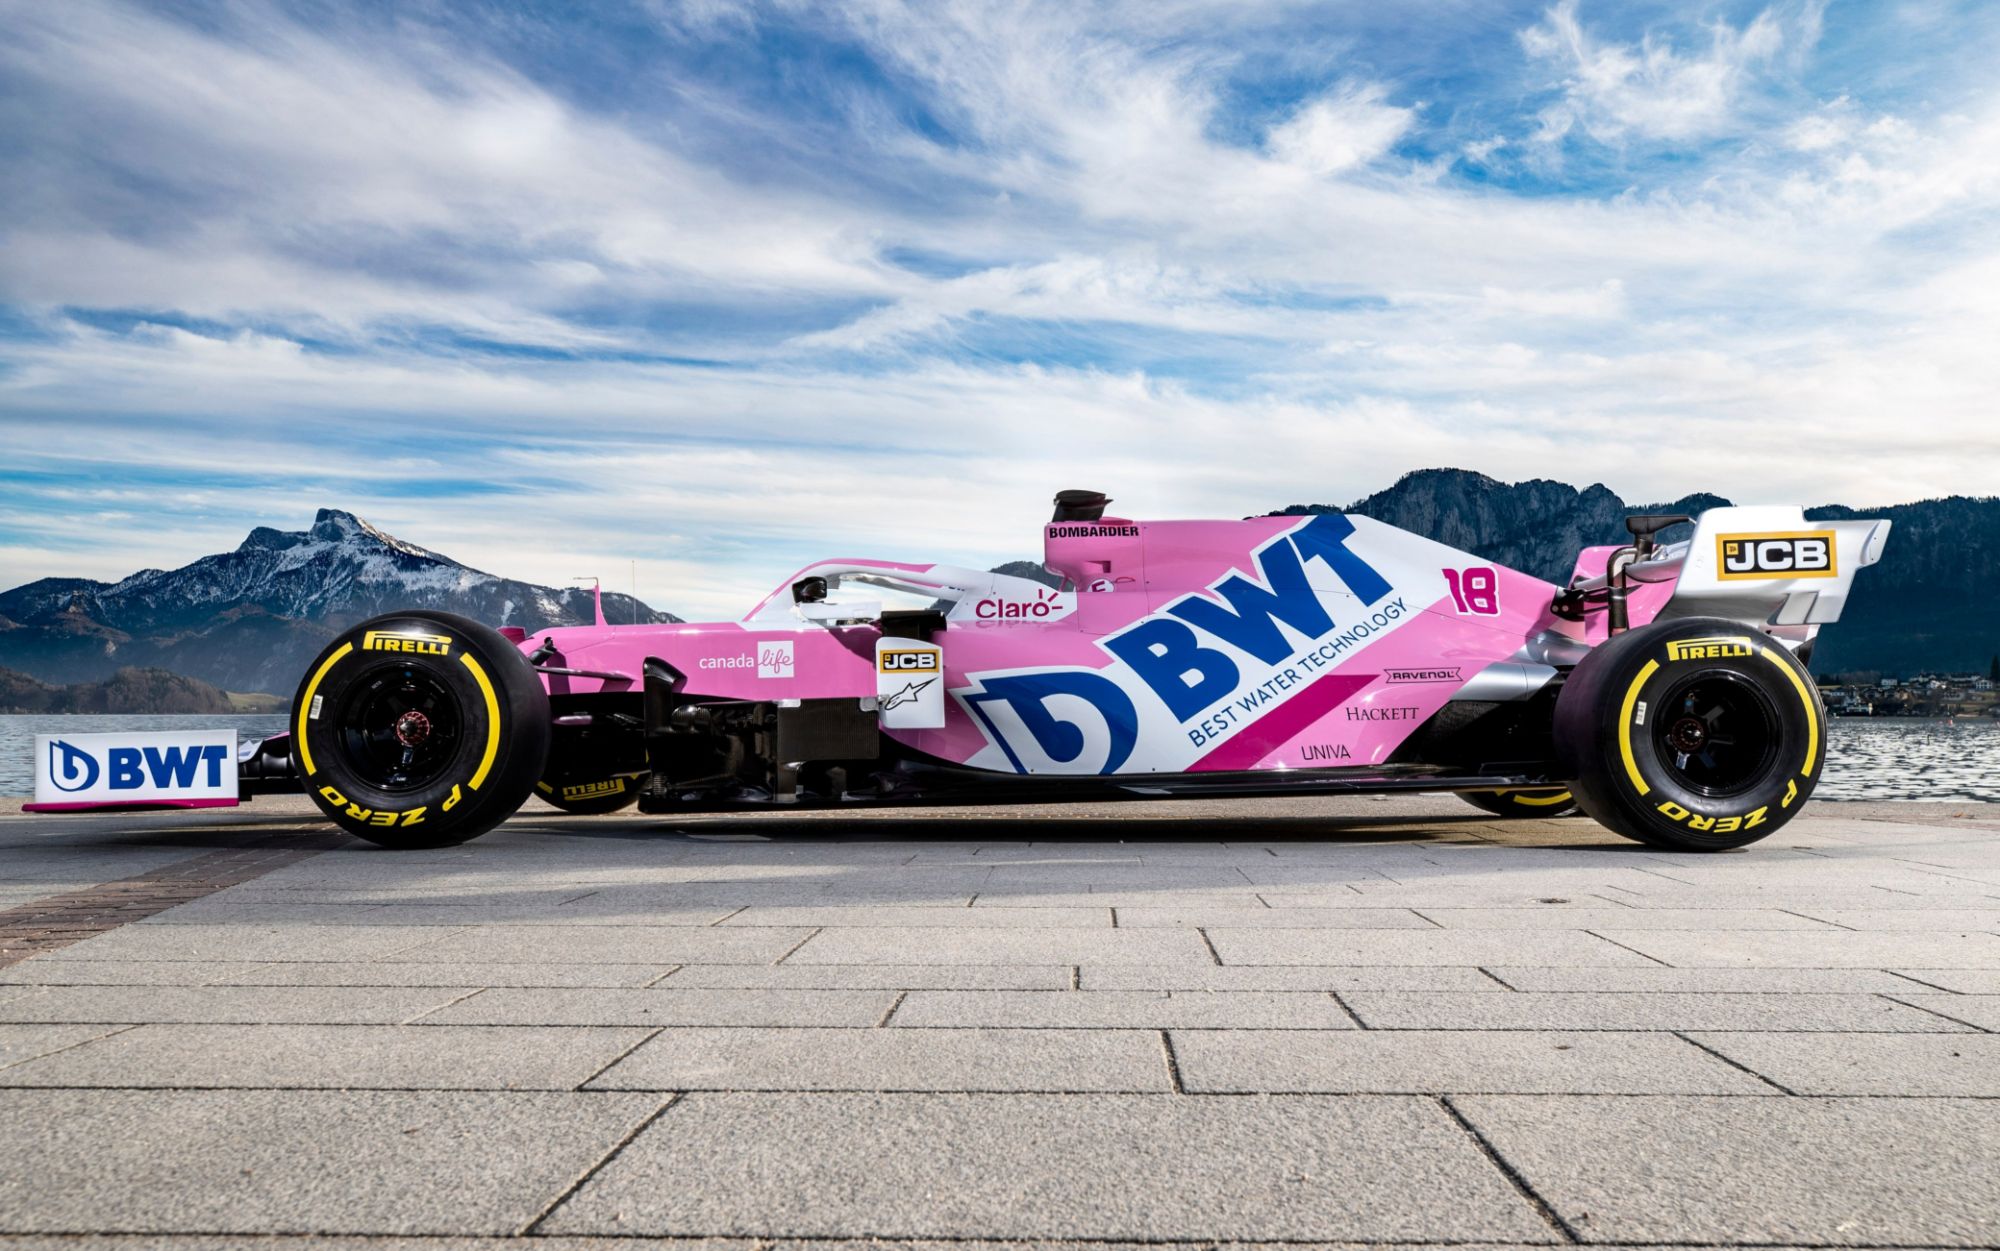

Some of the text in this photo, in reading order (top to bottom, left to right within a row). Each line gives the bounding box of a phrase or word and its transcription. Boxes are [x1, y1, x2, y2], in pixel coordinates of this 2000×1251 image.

[1049, 526, 1139, 538] BOMBARDIER
[1726, 540, 1828, 571] JCB
[1441, 567, 1499, 615] 18
[976, 597, 1050, 618] Claro
[1104, 514, 1394, 724] BWT
[362, 630, 453, 656] PIRELLI
[1666, 636, 1753, 661] PIRELLI
[699, 649, 795, 674] canada life
[884, 653, 936, 669] JCB
[1188, 597, 1408, 747] BEST WATER TECHNOLOGY
[1392, 671, 1455, 680] RAVENOL
[1346, 707, 1420, 721] HACKETT
[1301, 744, 1351, 761] UNIVA
[108, 745, 228, 790] BWT
[562, 778, 626, 800] PIRELLI
[319, 784, 462, 828] P ZERO
[1657, 779, 1798, 833] P ZERO
